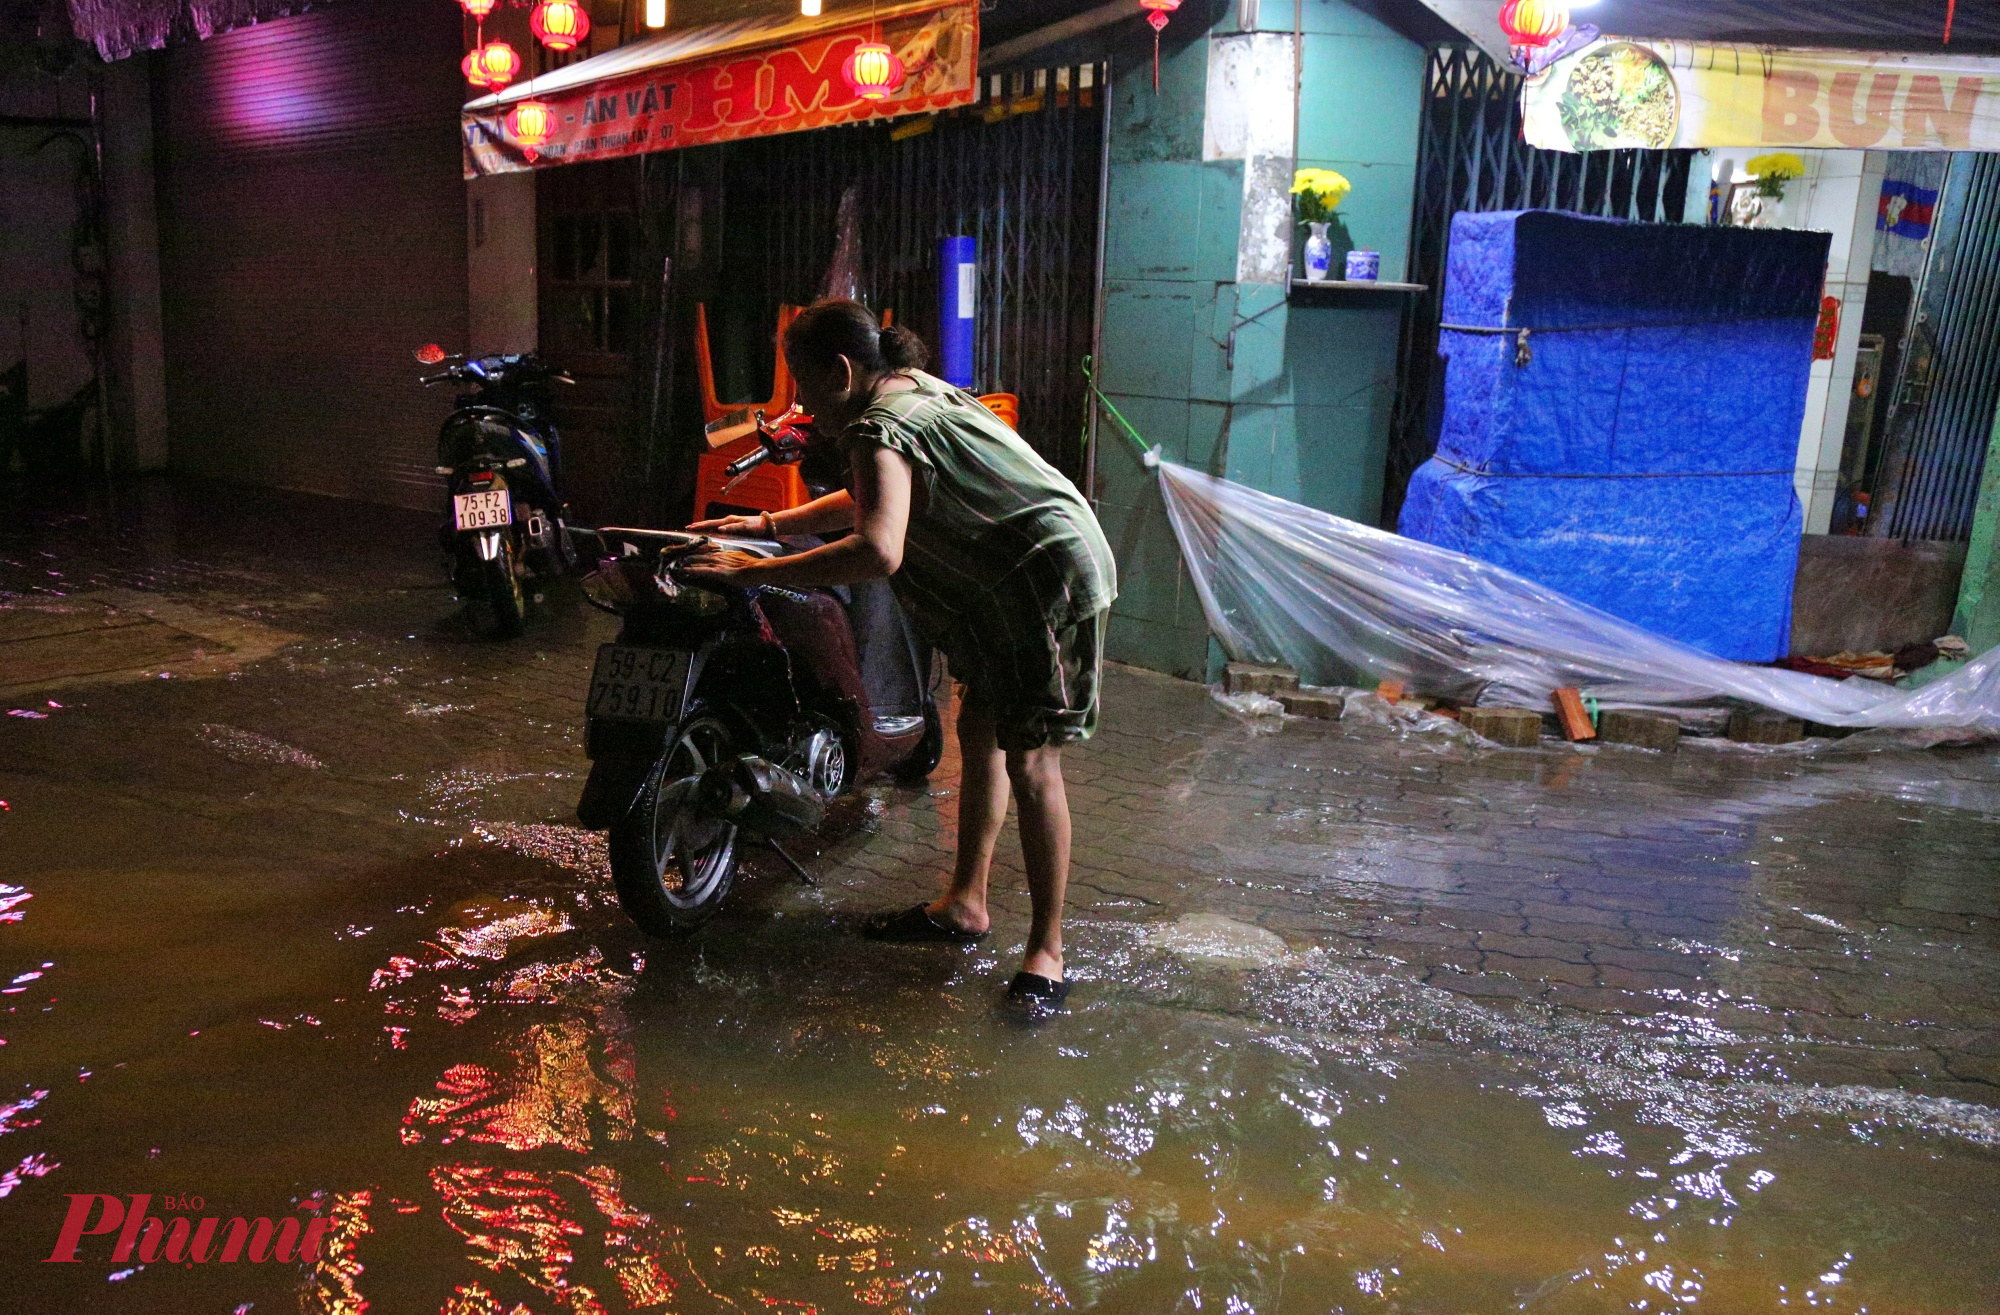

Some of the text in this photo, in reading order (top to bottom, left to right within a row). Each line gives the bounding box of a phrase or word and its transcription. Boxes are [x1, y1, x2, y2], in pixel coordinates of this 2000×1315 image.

[582, 95, 617, 126] ĂN
[626, 81, 677, 120] VẶT
[1761, 57, 1984, 148] BÚN
[459, 508, 508, 528] 109.38
[594, 682, 678, 718] 759.10
